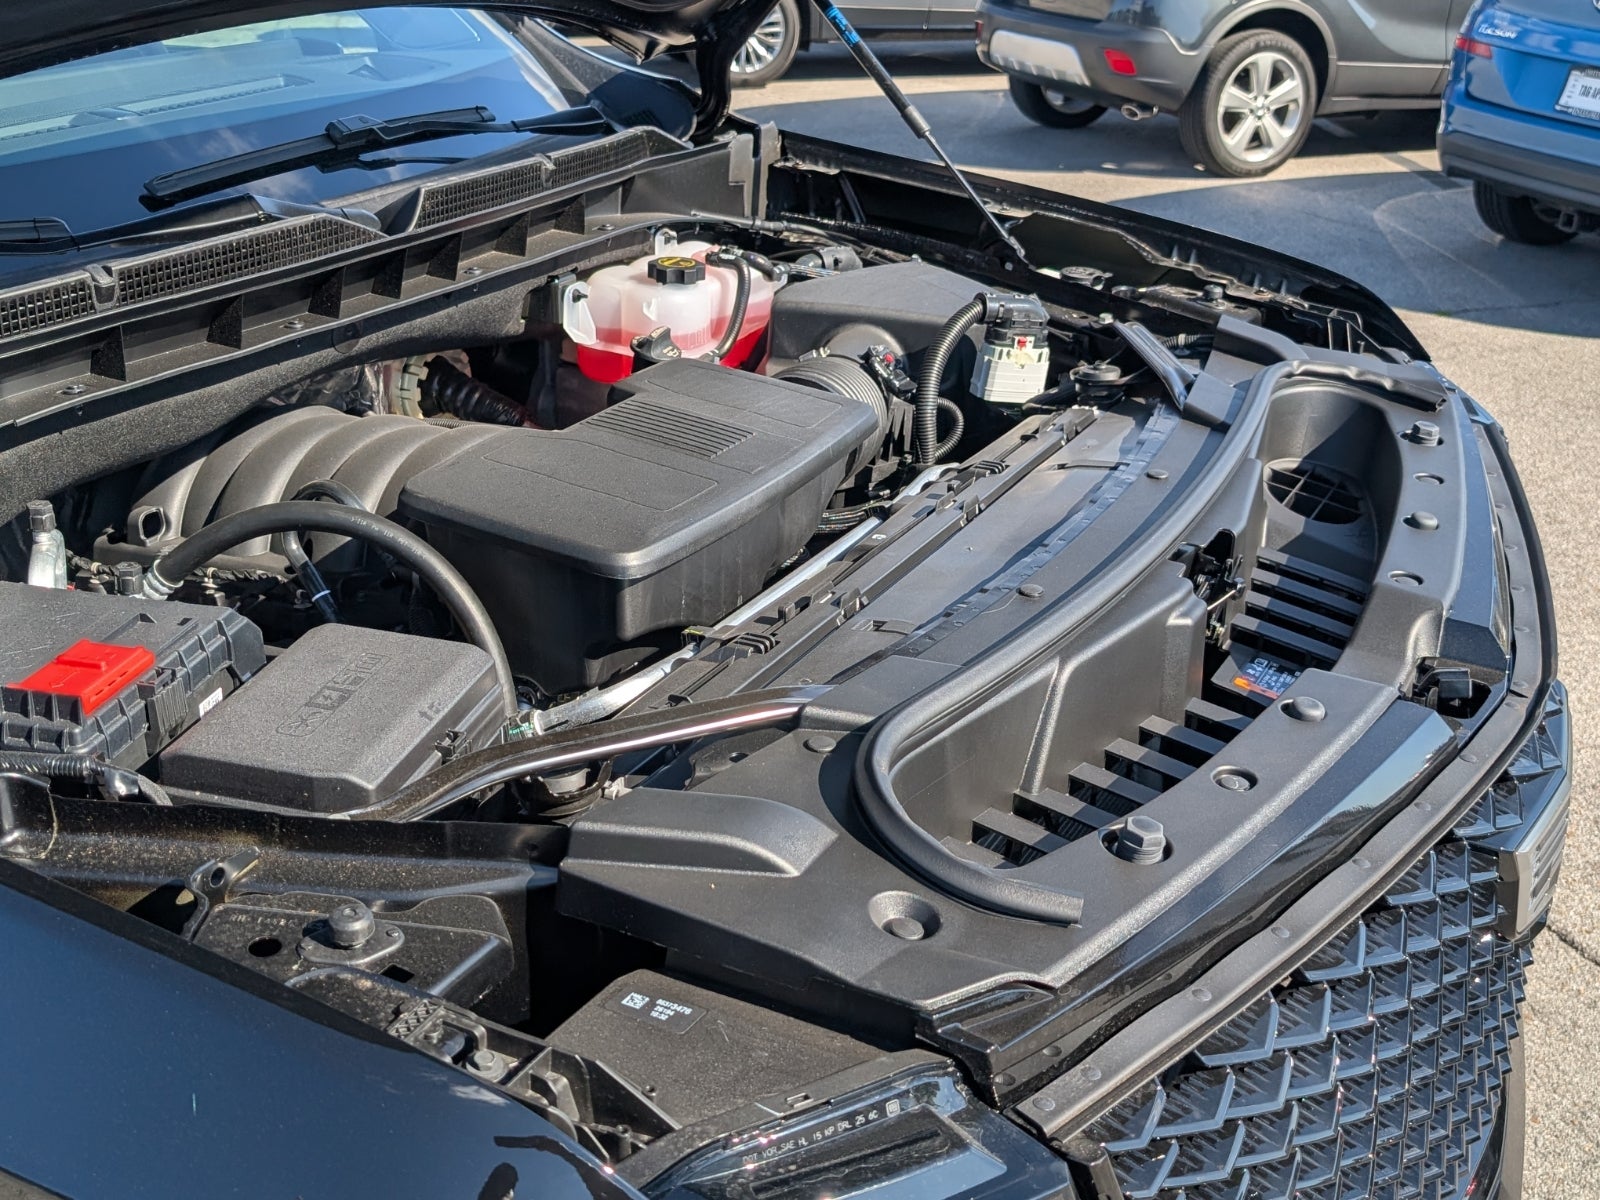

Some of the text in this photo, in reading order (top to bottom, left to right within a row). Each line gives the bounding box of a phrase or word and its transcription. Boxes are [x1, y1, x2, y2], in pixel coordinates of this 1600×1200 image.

[813, 1131, 823, 1141] 15
[837, 1121, 852, 1132] DRL
[855, 1114, 866, 1126] 25
